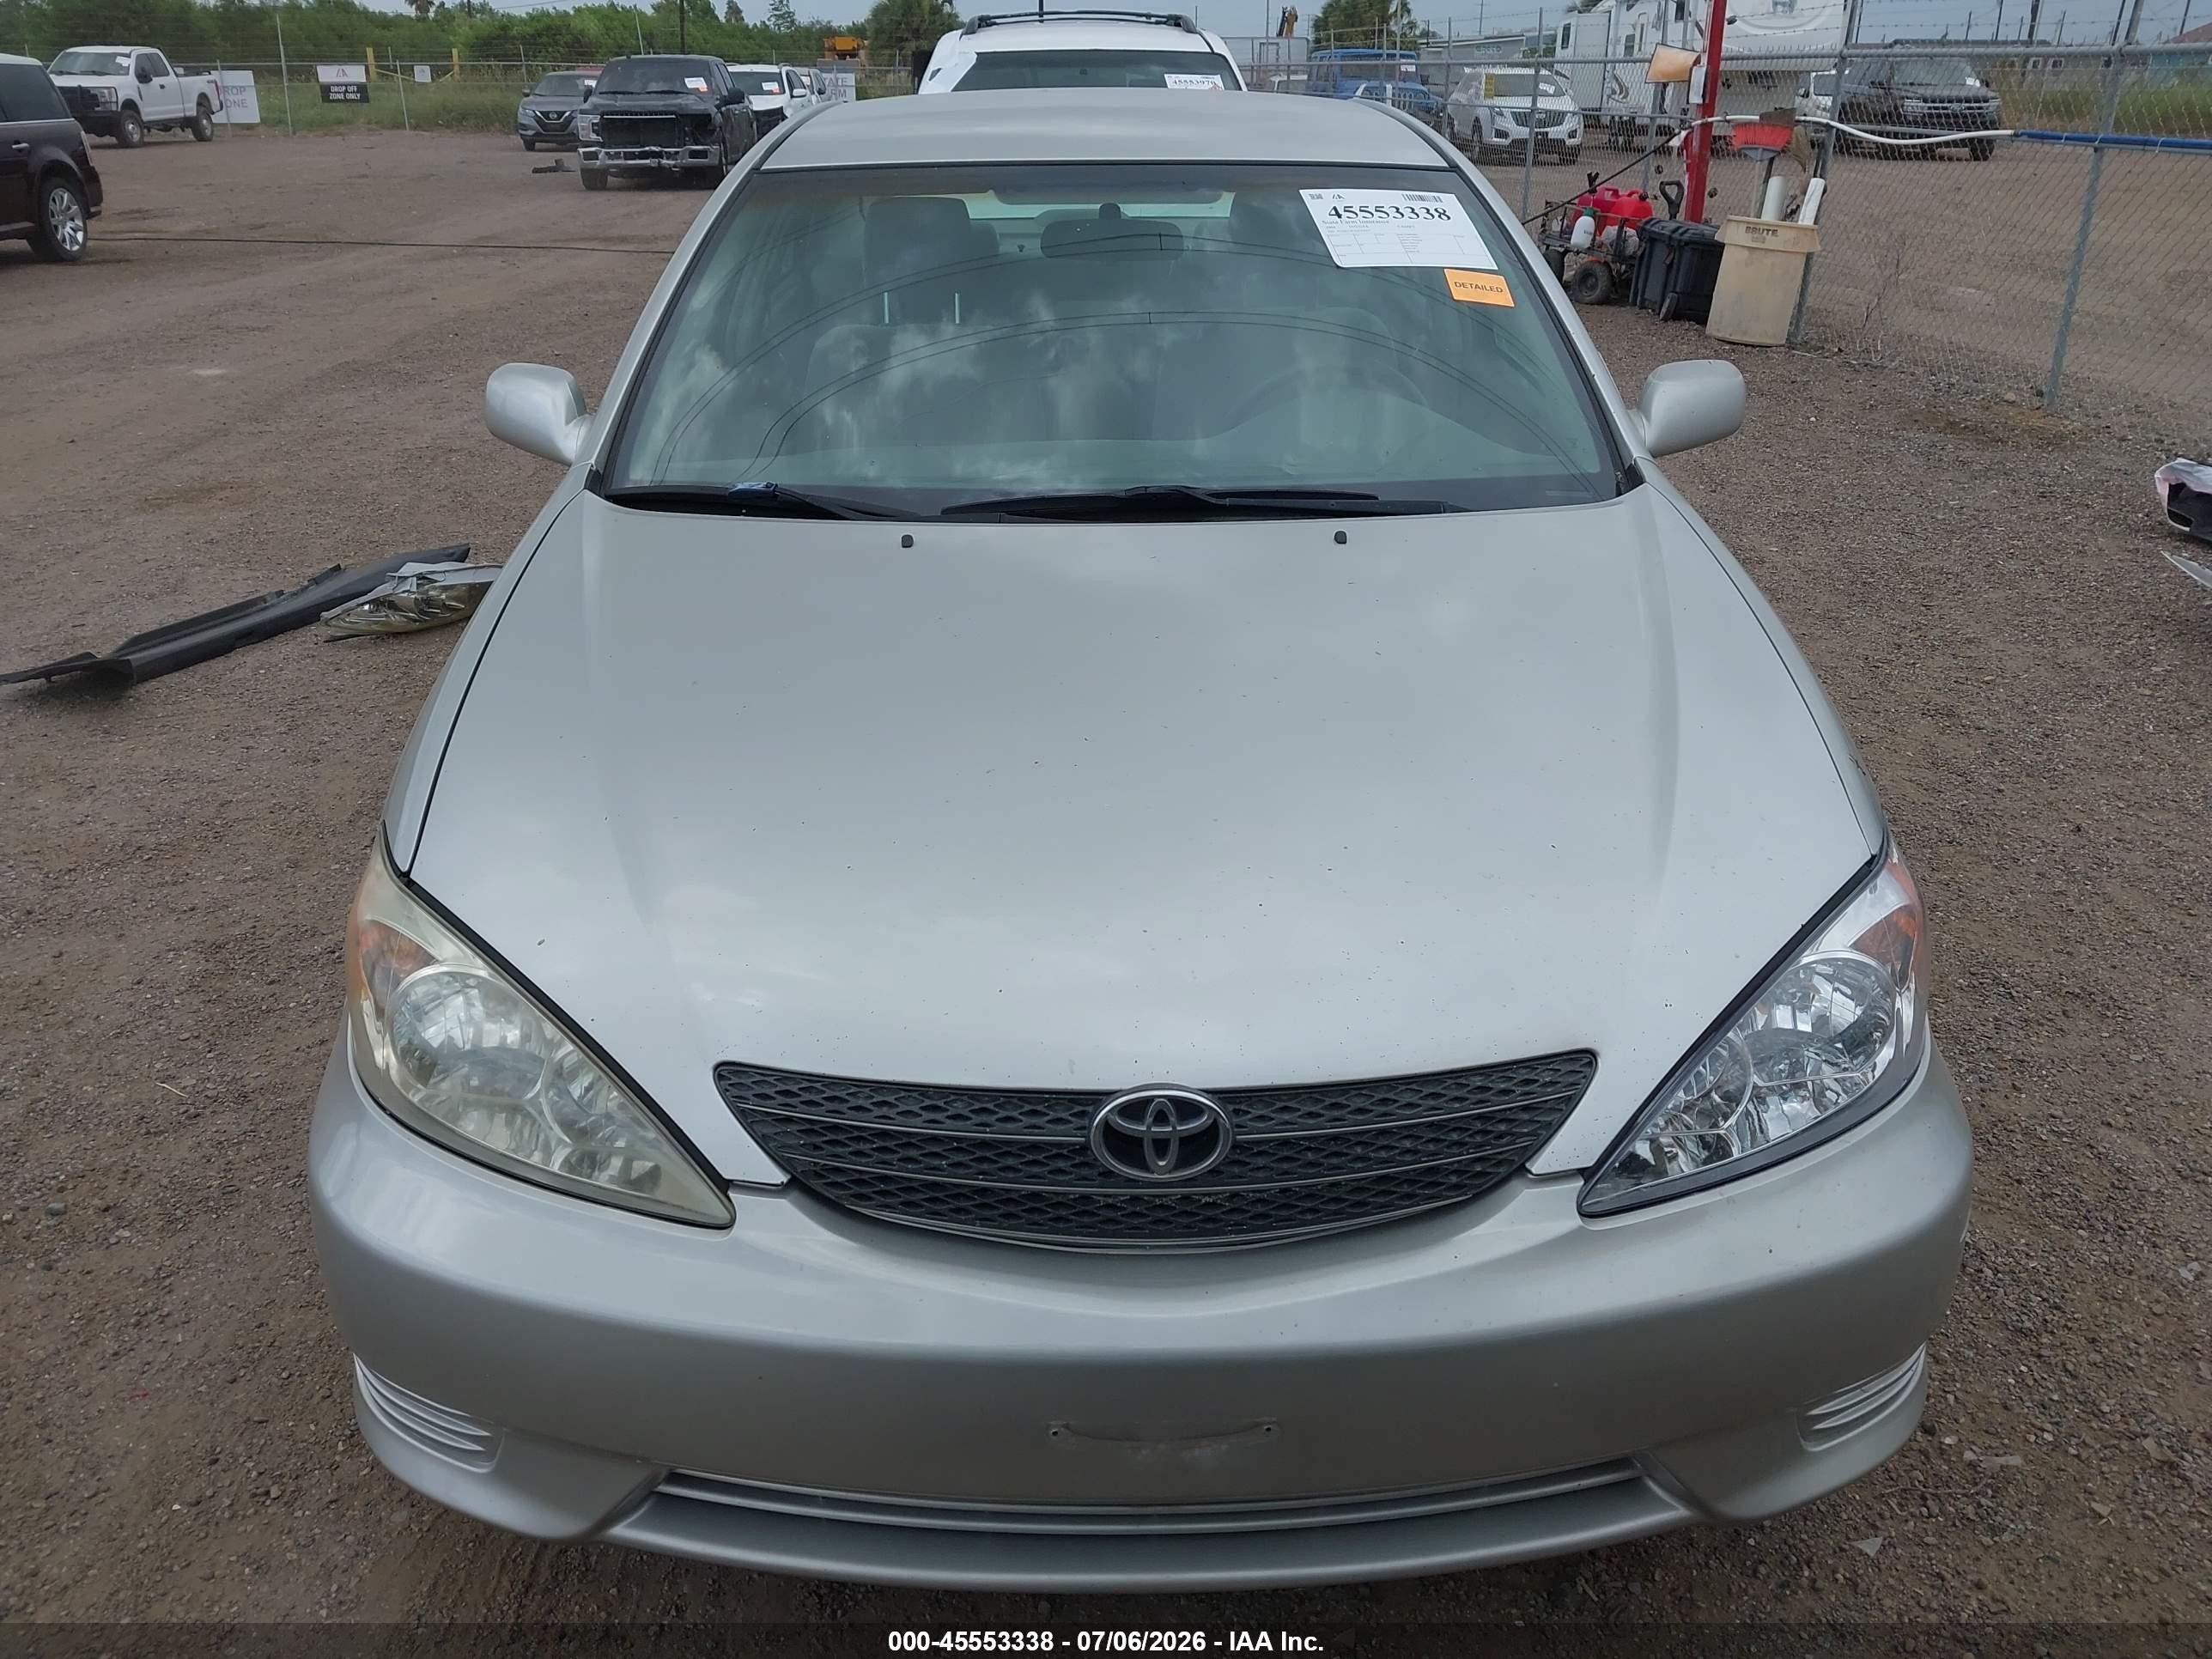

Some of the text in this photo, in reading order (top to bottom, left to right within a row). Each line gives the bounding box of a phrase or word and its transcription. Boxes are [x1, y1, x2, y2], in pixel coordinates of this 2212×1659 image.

[224, 98, 248, 108] ONE
[1328, 205, 1452, 222] 45553338
[1744, 226, 1779, 237] BRUTE
[1454, 281, 1504, 294] DETAILED
